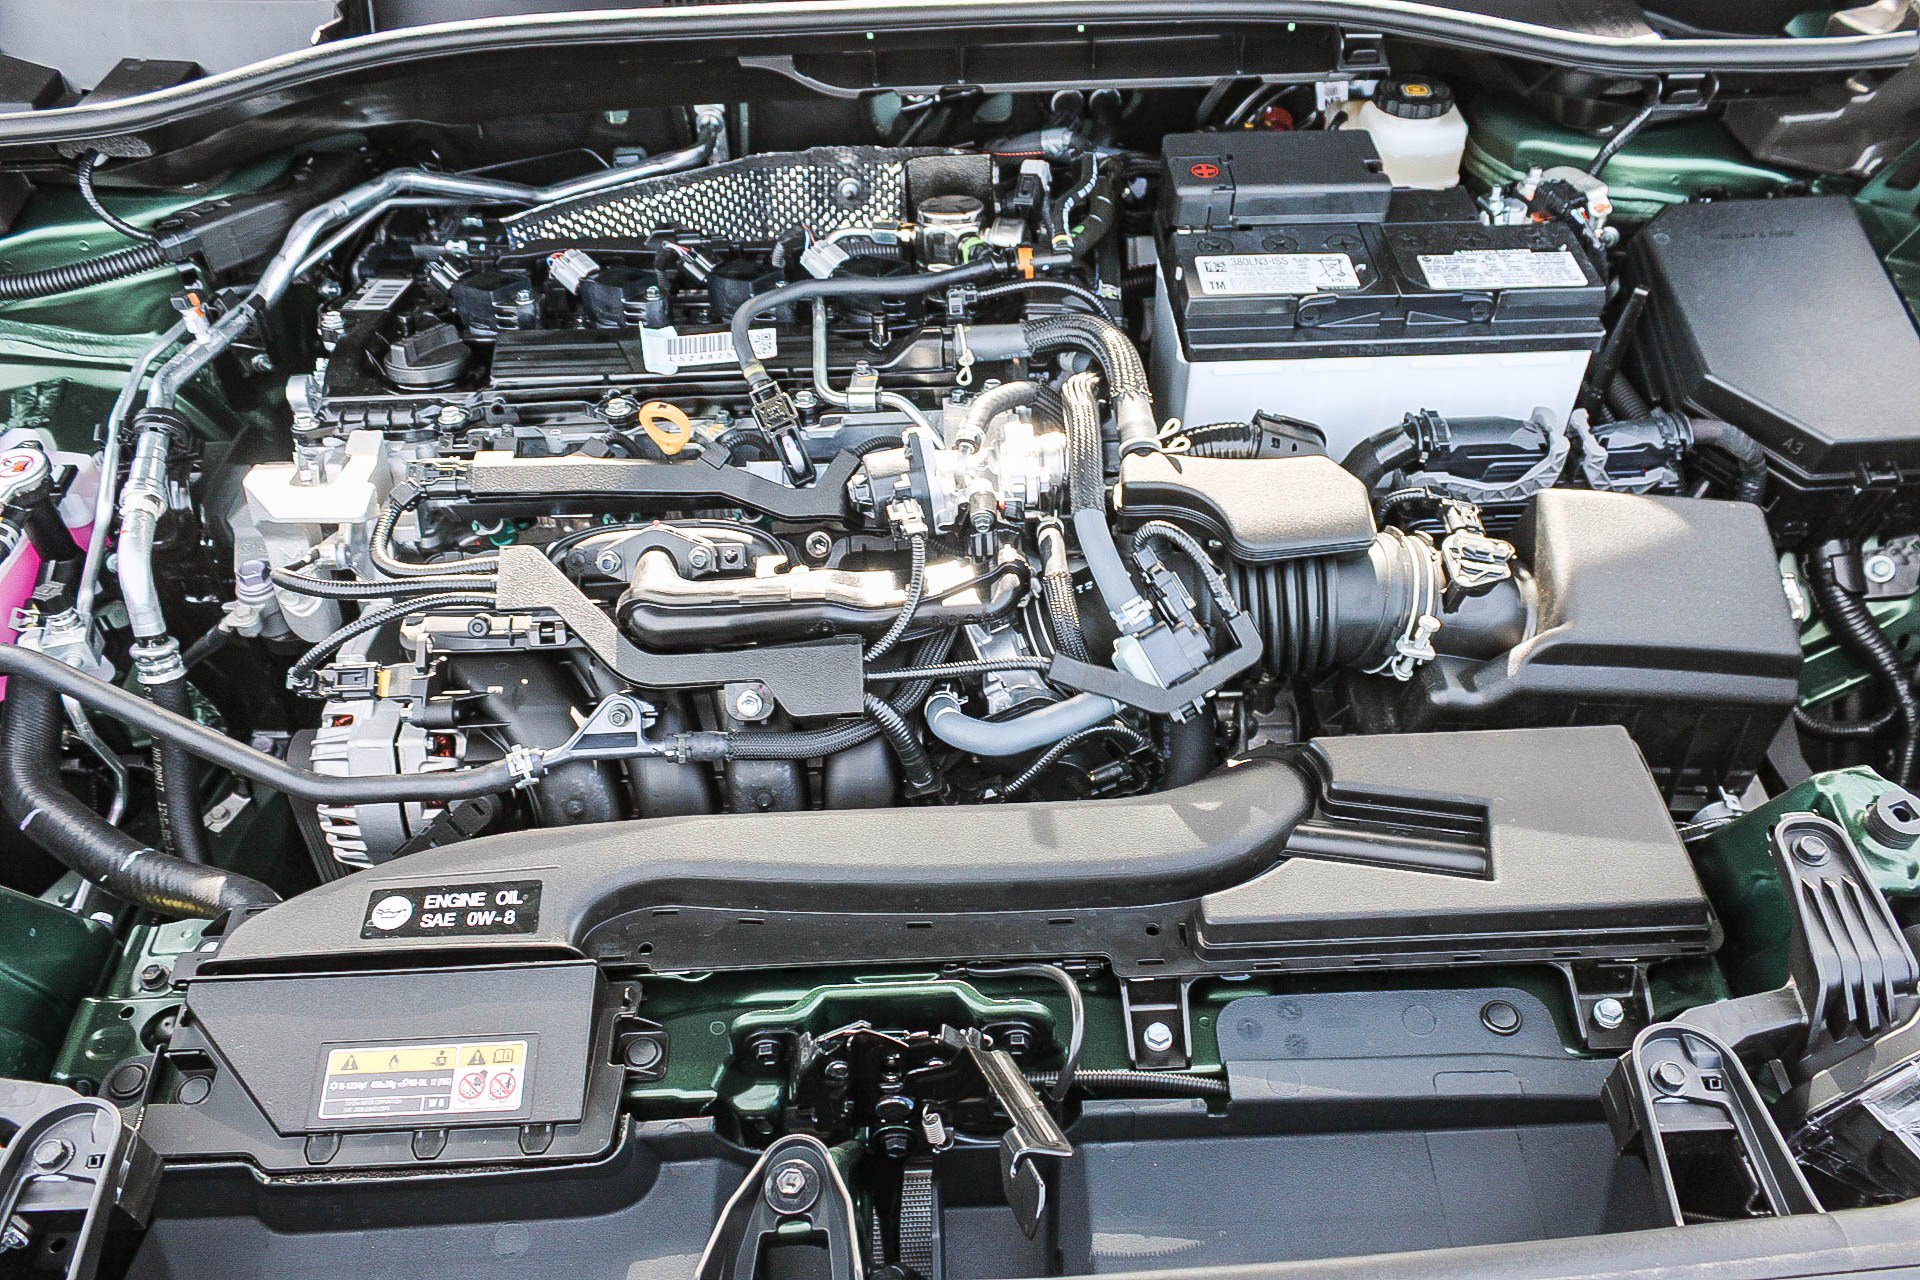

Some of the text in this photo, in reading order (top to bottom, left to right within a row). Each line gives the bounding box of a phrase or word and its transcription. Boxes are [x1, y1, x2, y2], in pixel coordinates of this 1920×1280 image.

[1209, 281, 1226, 290] TM
[423, 889, 524, 909] ENGINE OIL
[419, 909, 517, 928] SAE 0W-8
